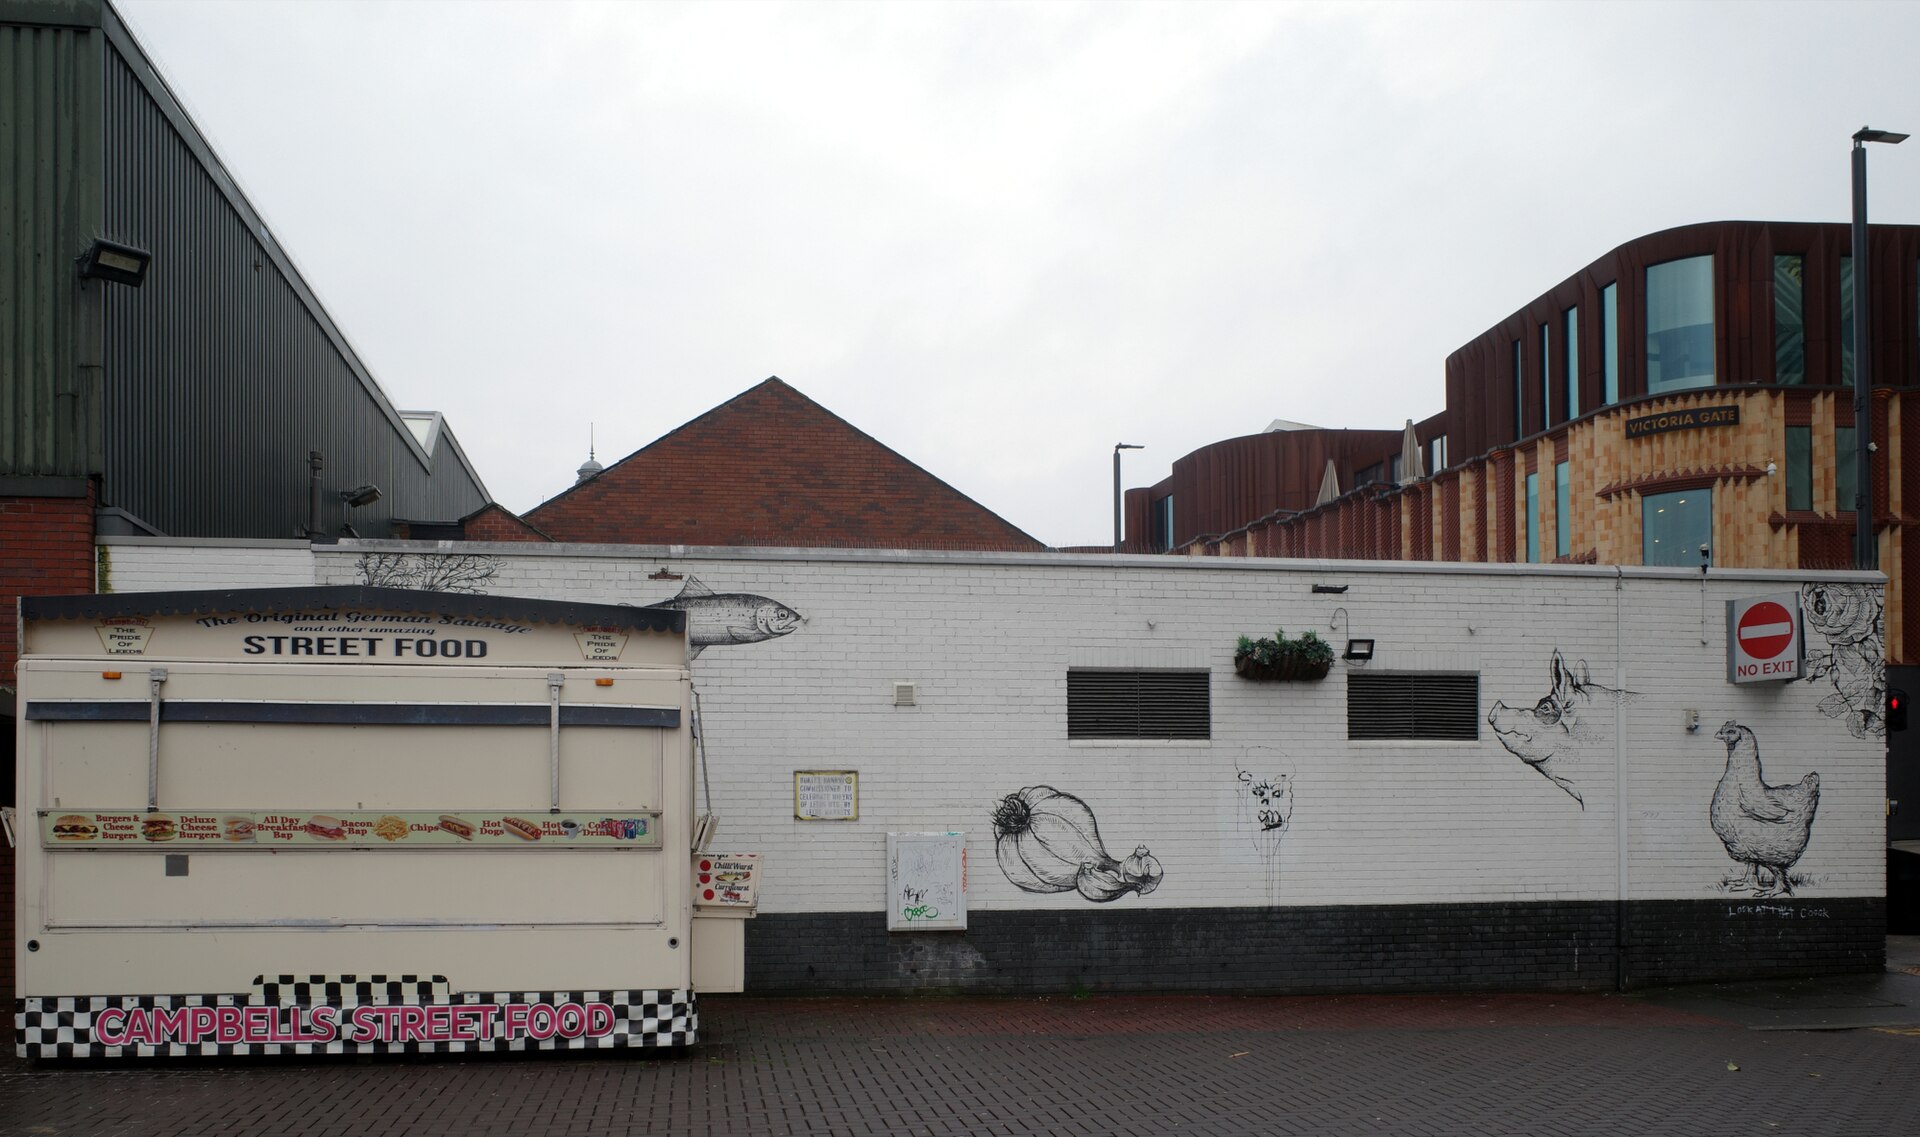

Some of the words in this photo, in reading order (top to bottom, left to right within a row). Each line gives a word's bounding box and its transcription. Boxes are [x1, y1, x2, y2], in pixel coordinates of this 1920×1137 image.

[1629, 414, 1694, 433] VICTORIA
[1700, 410, 1735, 423] GATE
[196, 616, 238, 628] The
[243, 611, 338, 624] Original
[345, 611, 432, 624] German
[438, 613, 532, 634] Sausage
[369, 626, 436, 635] amazing
[243, 635, 383, 656] STREET
[394, 638, 488, 658] FOOD
[1738, 664, 1758, 677] NO
[1763, 660, 1794, 674] EXIT
[96, 815, 132, 823] Burgers
[180, 816, 217, 824] Deluxe
[263, 816, 278, 824] All
[280, 816, 300, 825] Day
[103, 823, 135, 831] Cheese
[181, 823, 217, 832] Cheese
[257, 823, 307, 832] Breakfast
[410, 823, 439, 833] Chips
[482, 820, 501, 828] Hot
[542, 821, 561, 829] Hot
[102, 832, 138, 841] Burgers
[179, 831, 221, 840] Burgers
[273, 832, 293, 840] Bap
[348, 828, 368, 836] Bap
[479, 828, 504, 837] Dogs
[94, 1005, 338, 1047] CAMPBELLS
[350, 1003, 501, 1043] STREET
[504, 1002, 616, 1041] FOOD
